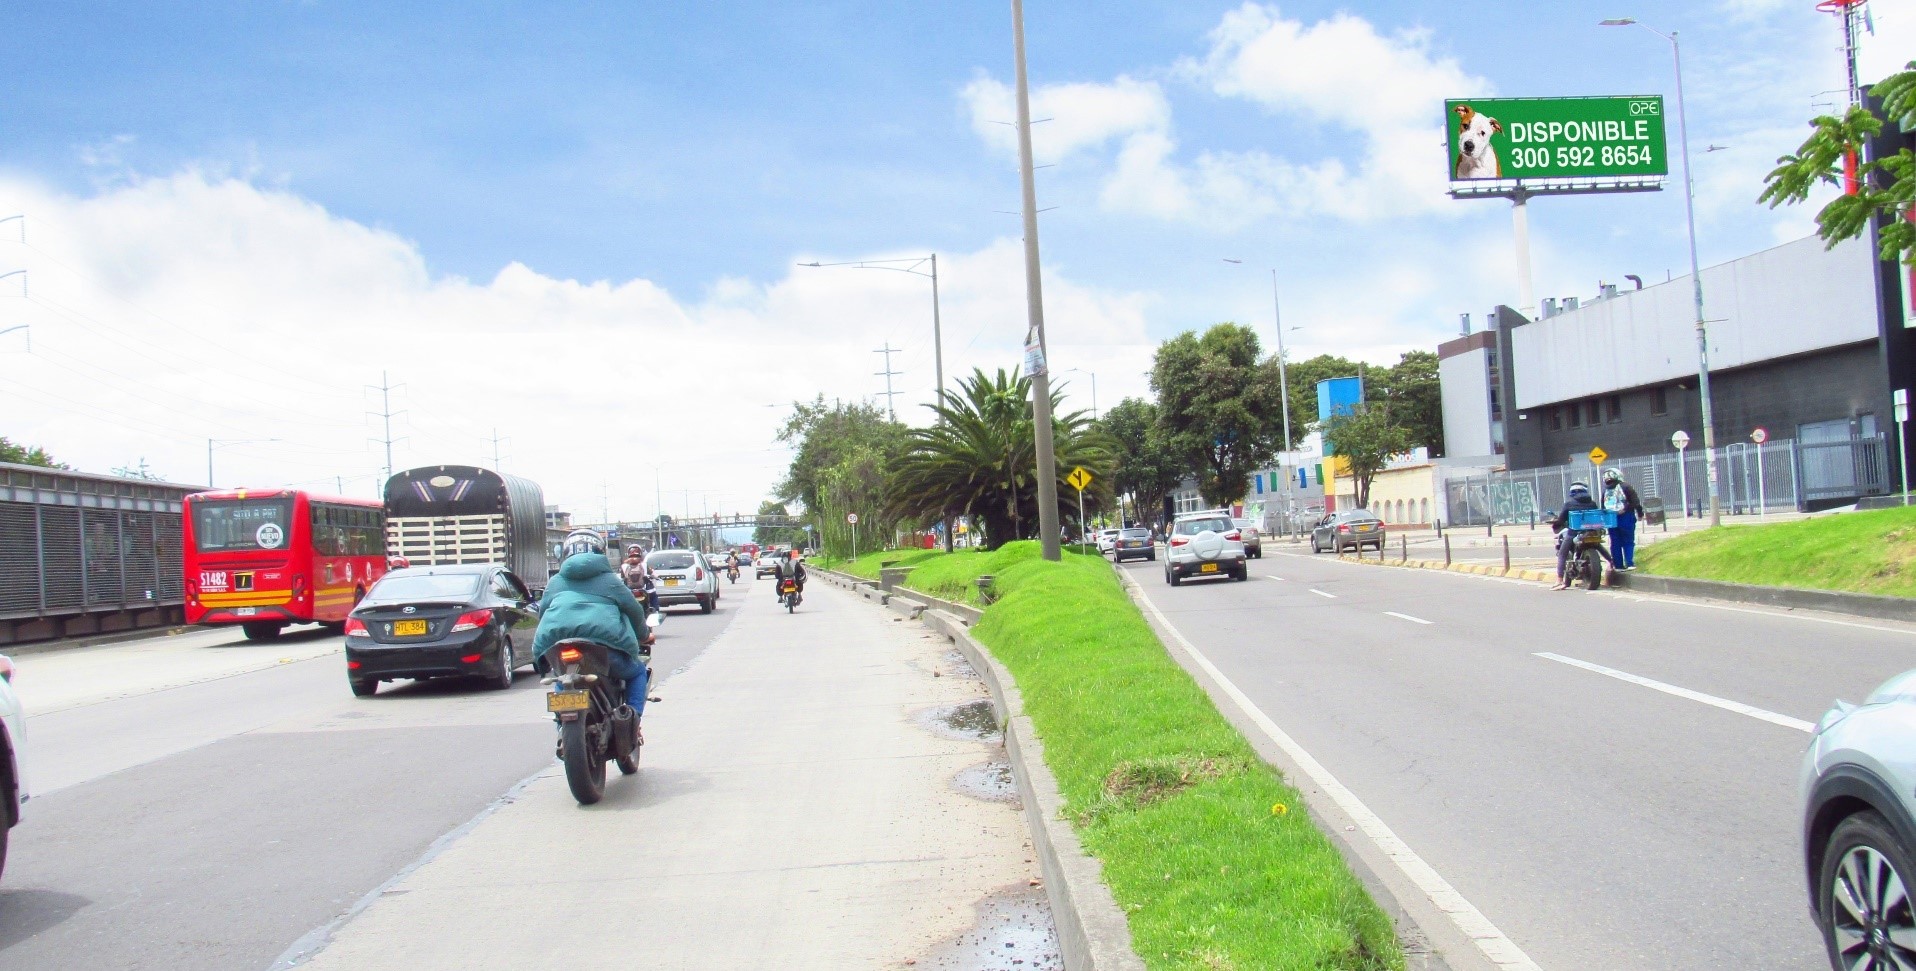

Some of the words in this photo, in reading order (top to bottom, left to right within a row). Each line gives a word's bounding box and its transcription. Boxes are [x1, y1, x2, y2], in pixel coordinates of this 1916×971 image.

[1630, 102, 1658, 114] OPE
[1510, 120, 1649, 143] DISPONIBLE
[1511, 147, 1550, 168] 300
[1556, 146, 1595, 167] 592
[1601, 145, 1652, 166] 8654
[200, 571, 227, 586] S1482
[396, 622, 408, 631] HTL
[411, 622, 424, 631] 384
